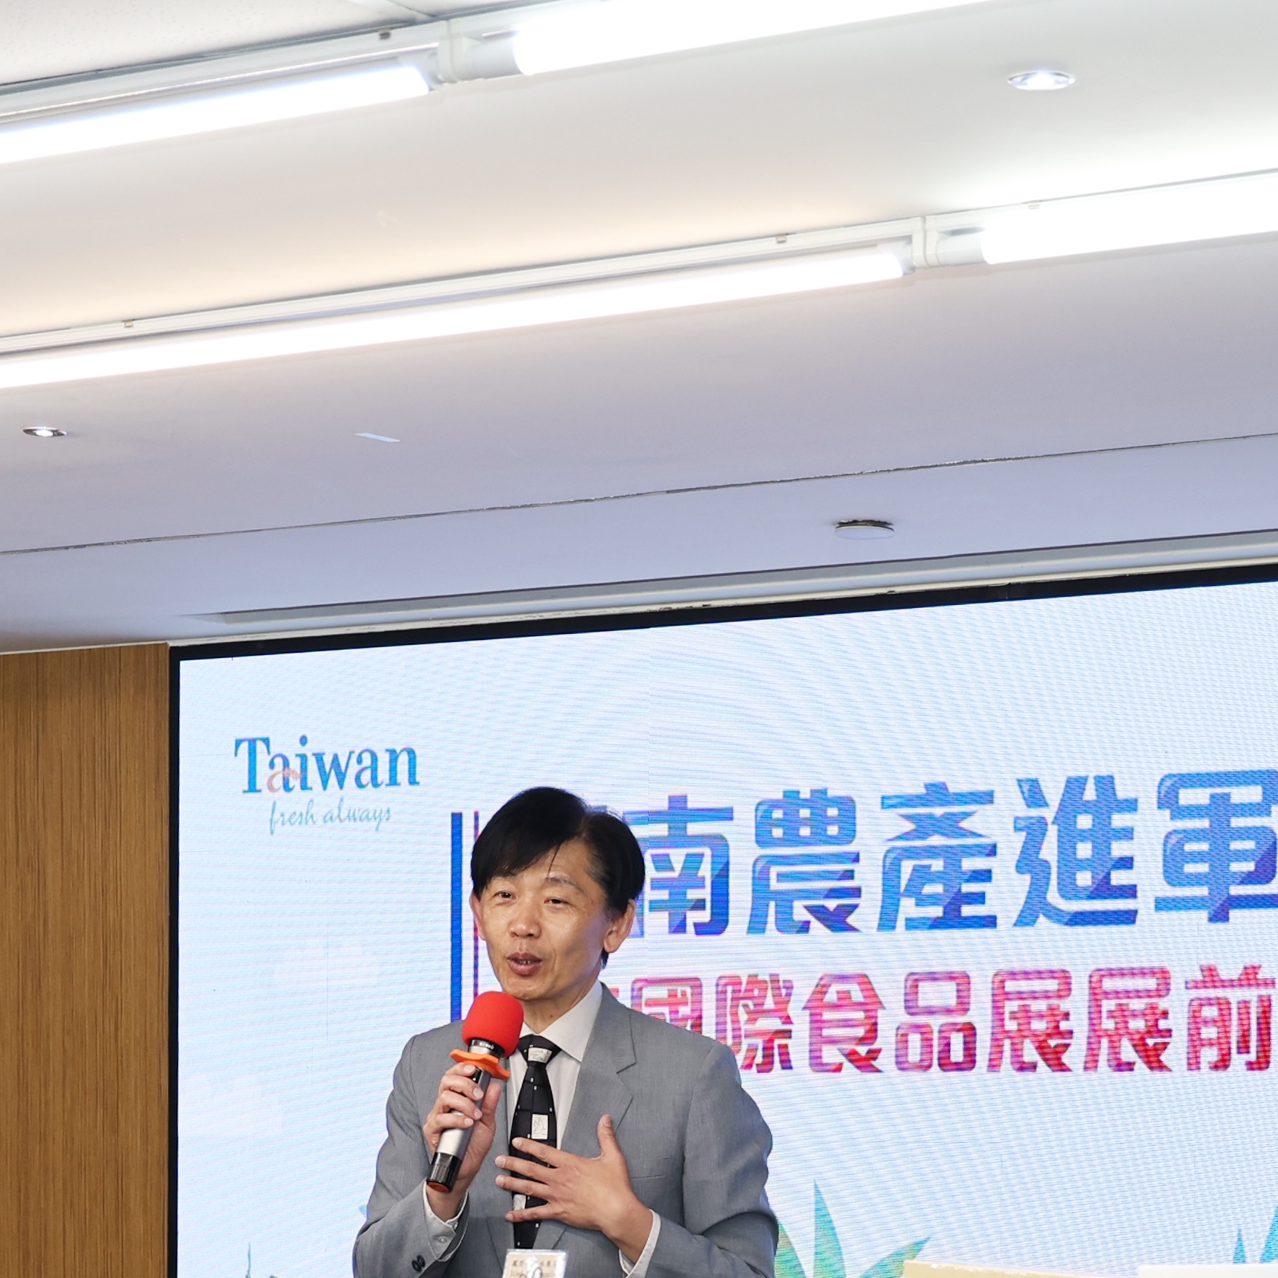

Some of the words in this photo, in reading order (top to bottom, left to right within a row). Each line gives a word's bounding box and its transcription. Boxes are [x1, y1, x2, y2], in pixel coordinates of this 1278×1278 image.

[234, 735, 420, 793] Taiwan
[269, 799, 316, 835] fresh
[323, 797, 392, 832] always
